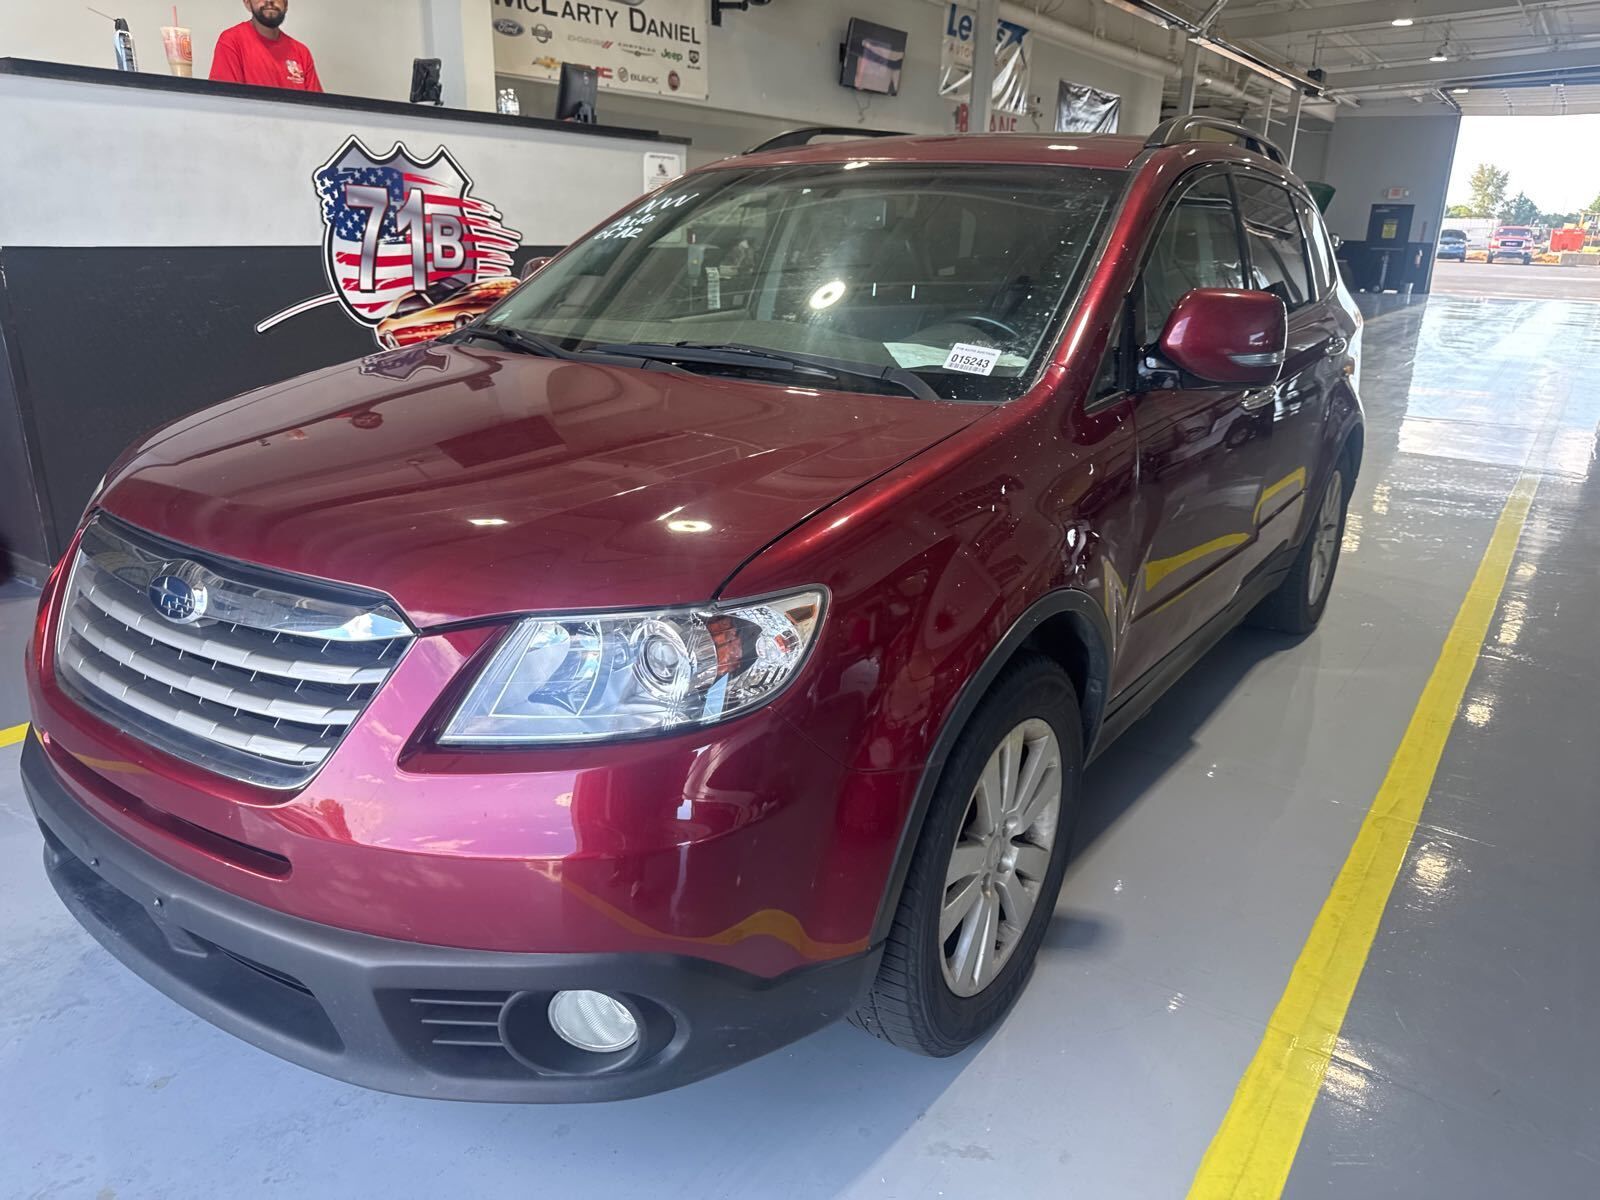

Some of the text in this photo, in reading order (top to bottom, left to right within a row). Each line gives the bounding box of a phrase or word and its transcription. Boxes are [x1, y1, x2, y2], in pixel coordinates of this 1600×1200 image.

[629, 7, 702, 45] DANIEL
[661, 48, 683, 62] Jeep
[630, 73, 659, 84] BUICK
[345, 184, 465, 293] 71B
[951, 354, 990, 368] 015243
